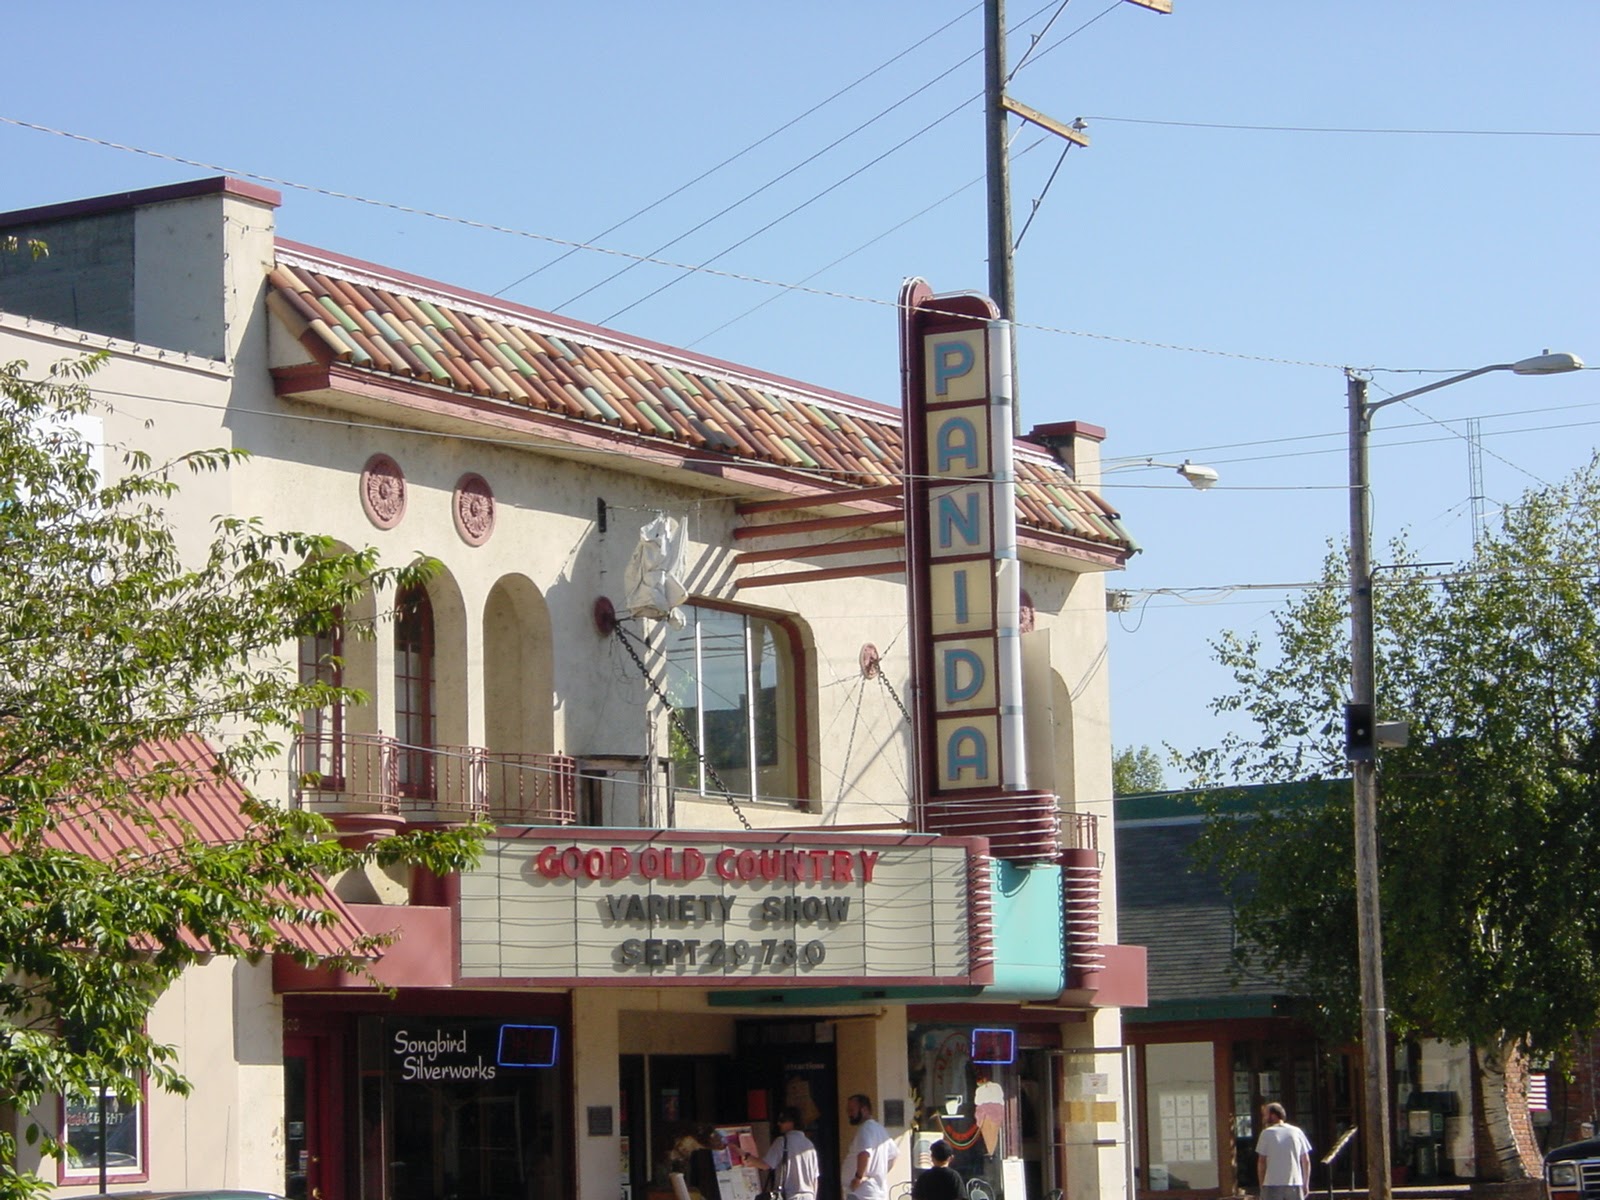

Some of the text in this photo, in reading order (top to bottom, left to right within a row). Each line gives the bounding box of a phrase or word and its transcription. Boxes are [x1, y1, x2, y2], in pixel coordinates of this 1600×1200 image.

[933, 340, 988, 781] PANIDA
[534, 846, 879, 882] GOOD OLD COUNTRY
[606, 894, 850, 922] VARIETY SHOW
[622, 938, 700, 965] SEPT
[394, 1029, 467, 1061] Songbird
[402, 1055, 496, 1080] Silverworks
